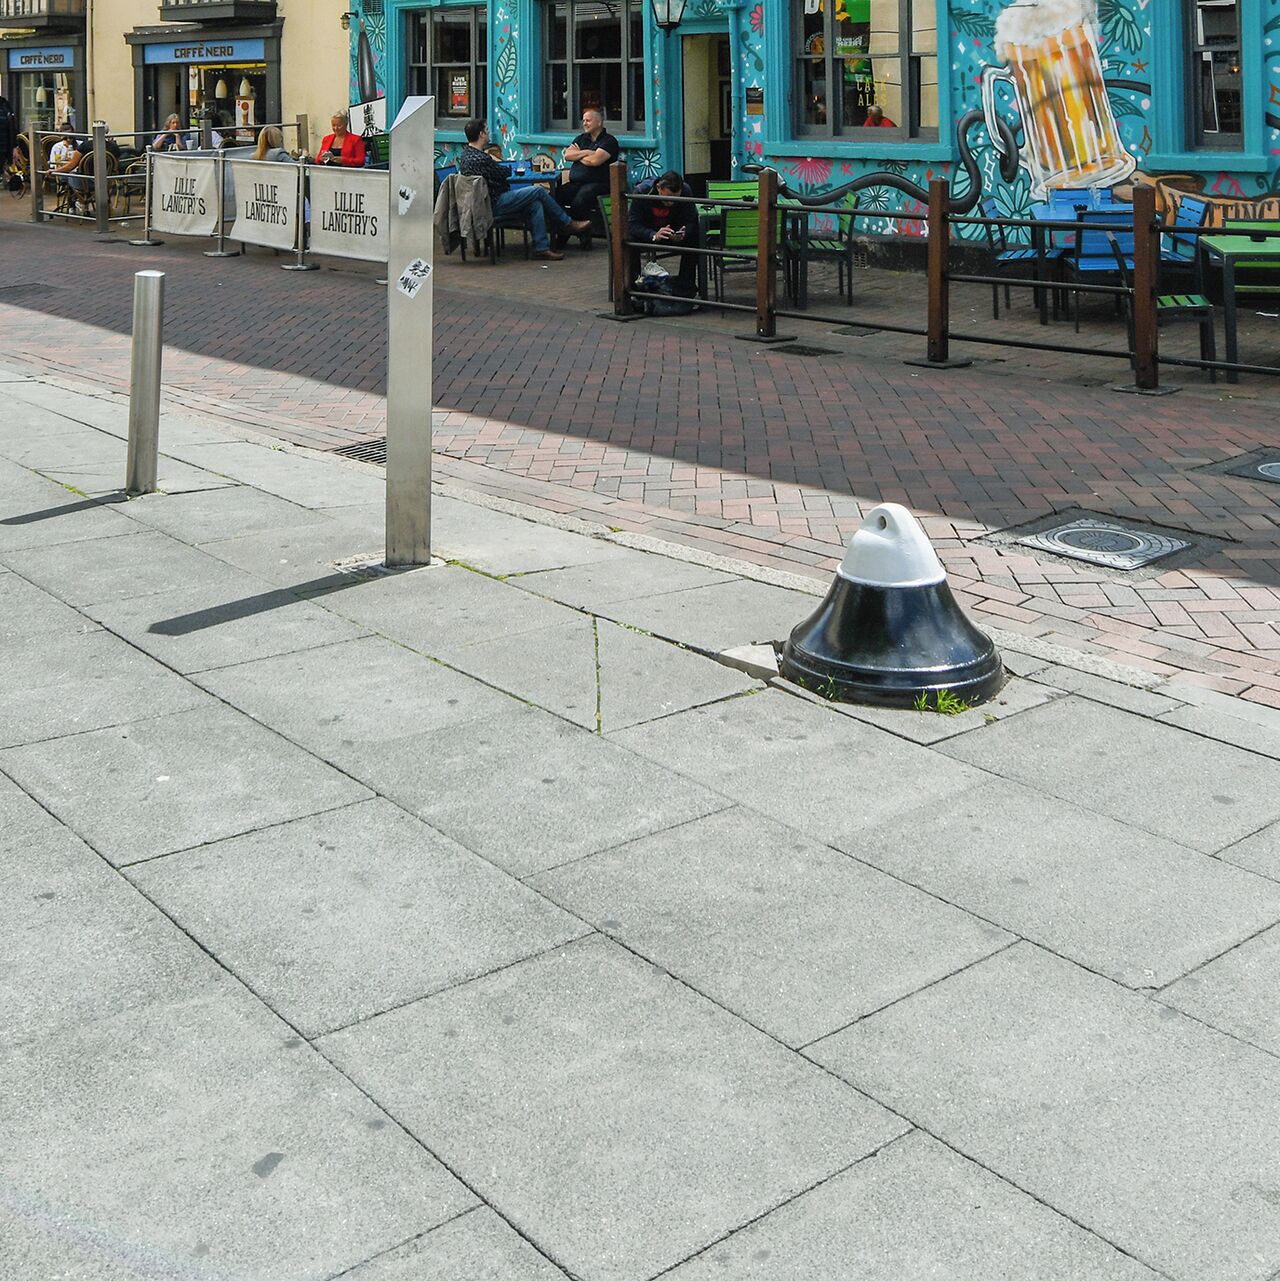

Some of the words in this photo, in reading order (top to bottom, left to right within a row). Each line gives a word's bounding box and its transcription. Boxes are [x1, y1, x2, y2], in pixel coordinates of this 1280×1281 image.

[43, 54, 64, 64] NERO
[206, 45, 234, 57] NERO
[174, 177, 196, 196] LILLIE
[254, 183, 278, 203] LILLIE
[161, 194, 206, 216] LANGTRY'S
[334, 191, 365, 214] LILLIE
[245, 201, 287, 226] LANGTRY'S
[322, 211, 378, 237] LANGTRY'S
